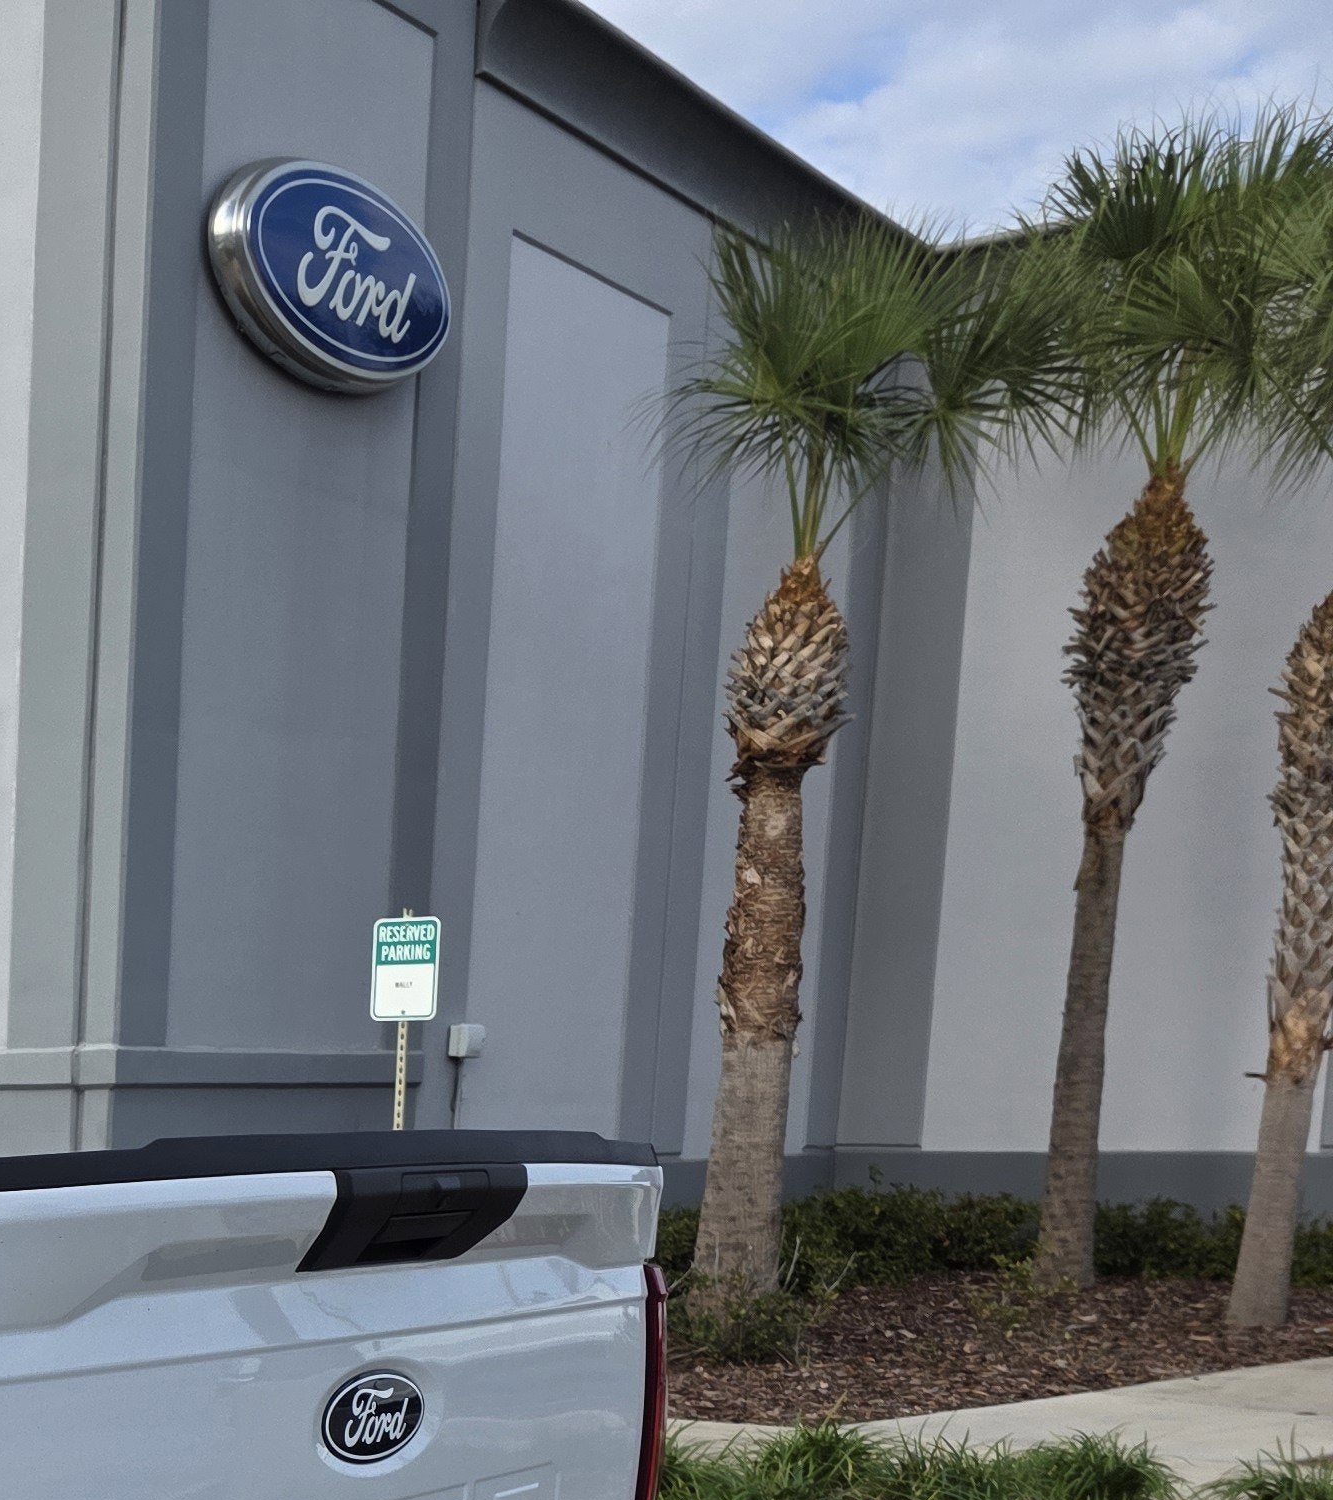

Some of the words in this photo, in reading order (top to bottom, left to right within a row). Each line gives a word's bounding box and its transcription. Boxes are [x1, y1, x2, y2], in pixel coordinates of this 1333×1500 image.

[296, 204, 417, 344] Ford
[378, 924, 436, 943] RESERVED
[380, 943, 432, 962] PARKING
[343, 1386, 410, 1448] Ford
